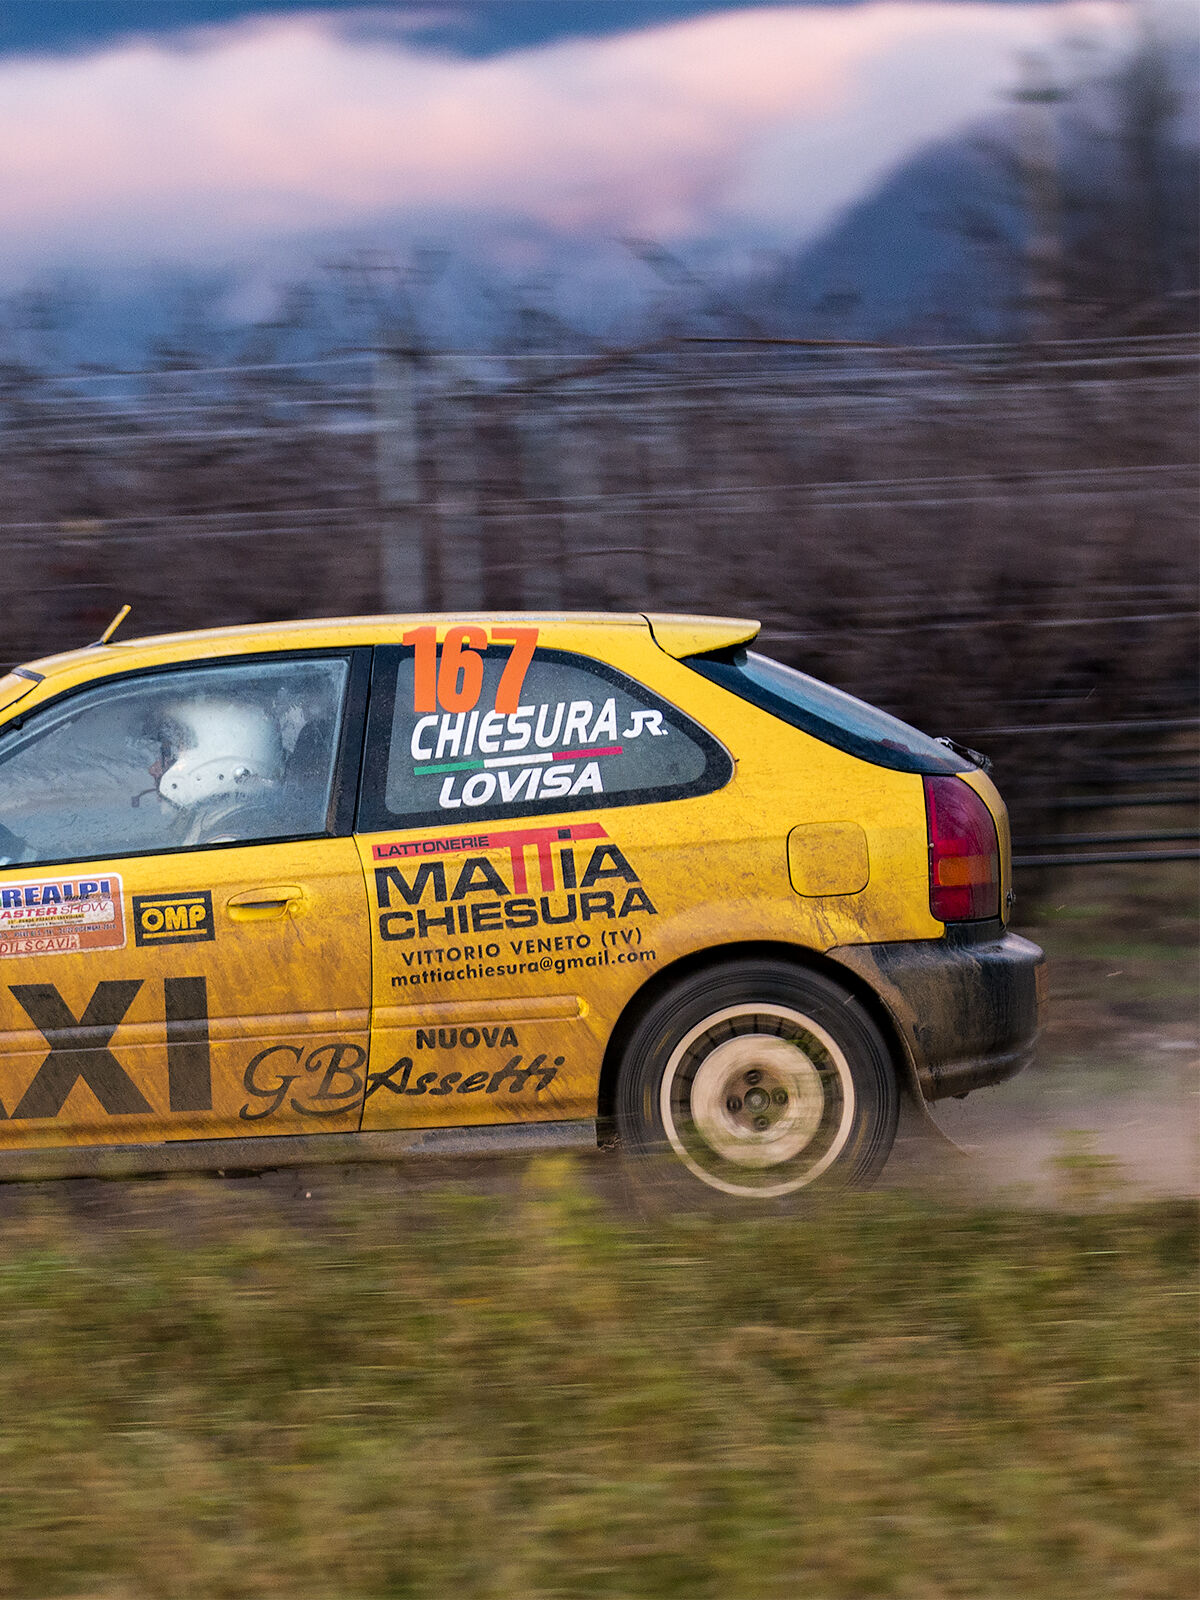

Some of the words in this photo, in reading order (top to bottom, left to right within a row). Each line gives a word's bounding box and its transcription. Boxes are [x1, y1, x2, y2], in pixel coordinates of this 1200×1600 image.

[402, 626, 539, 714] 167
[411, 698, 618, 760] CHIESURA
[622, 709, 668, 738] JR.
[439, 762, 603, 808] LOVISA
[377, 836, 489, 857] LATTONERIE
[60, 902, 108, 915] SHOW
[141, 903, 207, 932] OMP
[379, 887, 658, 942] CHIESURA
[402, 943, 500, 967] VITTORIO
[510, 934, 591, 957] VENETO
[601, 927, 642, 948] (TV)
[391, 950, 657, 988] mattiachiesura@gmail.com
[416, 1027, 519, 1050] NUOVA
[364, 1054, 565, 1101] Assetti
